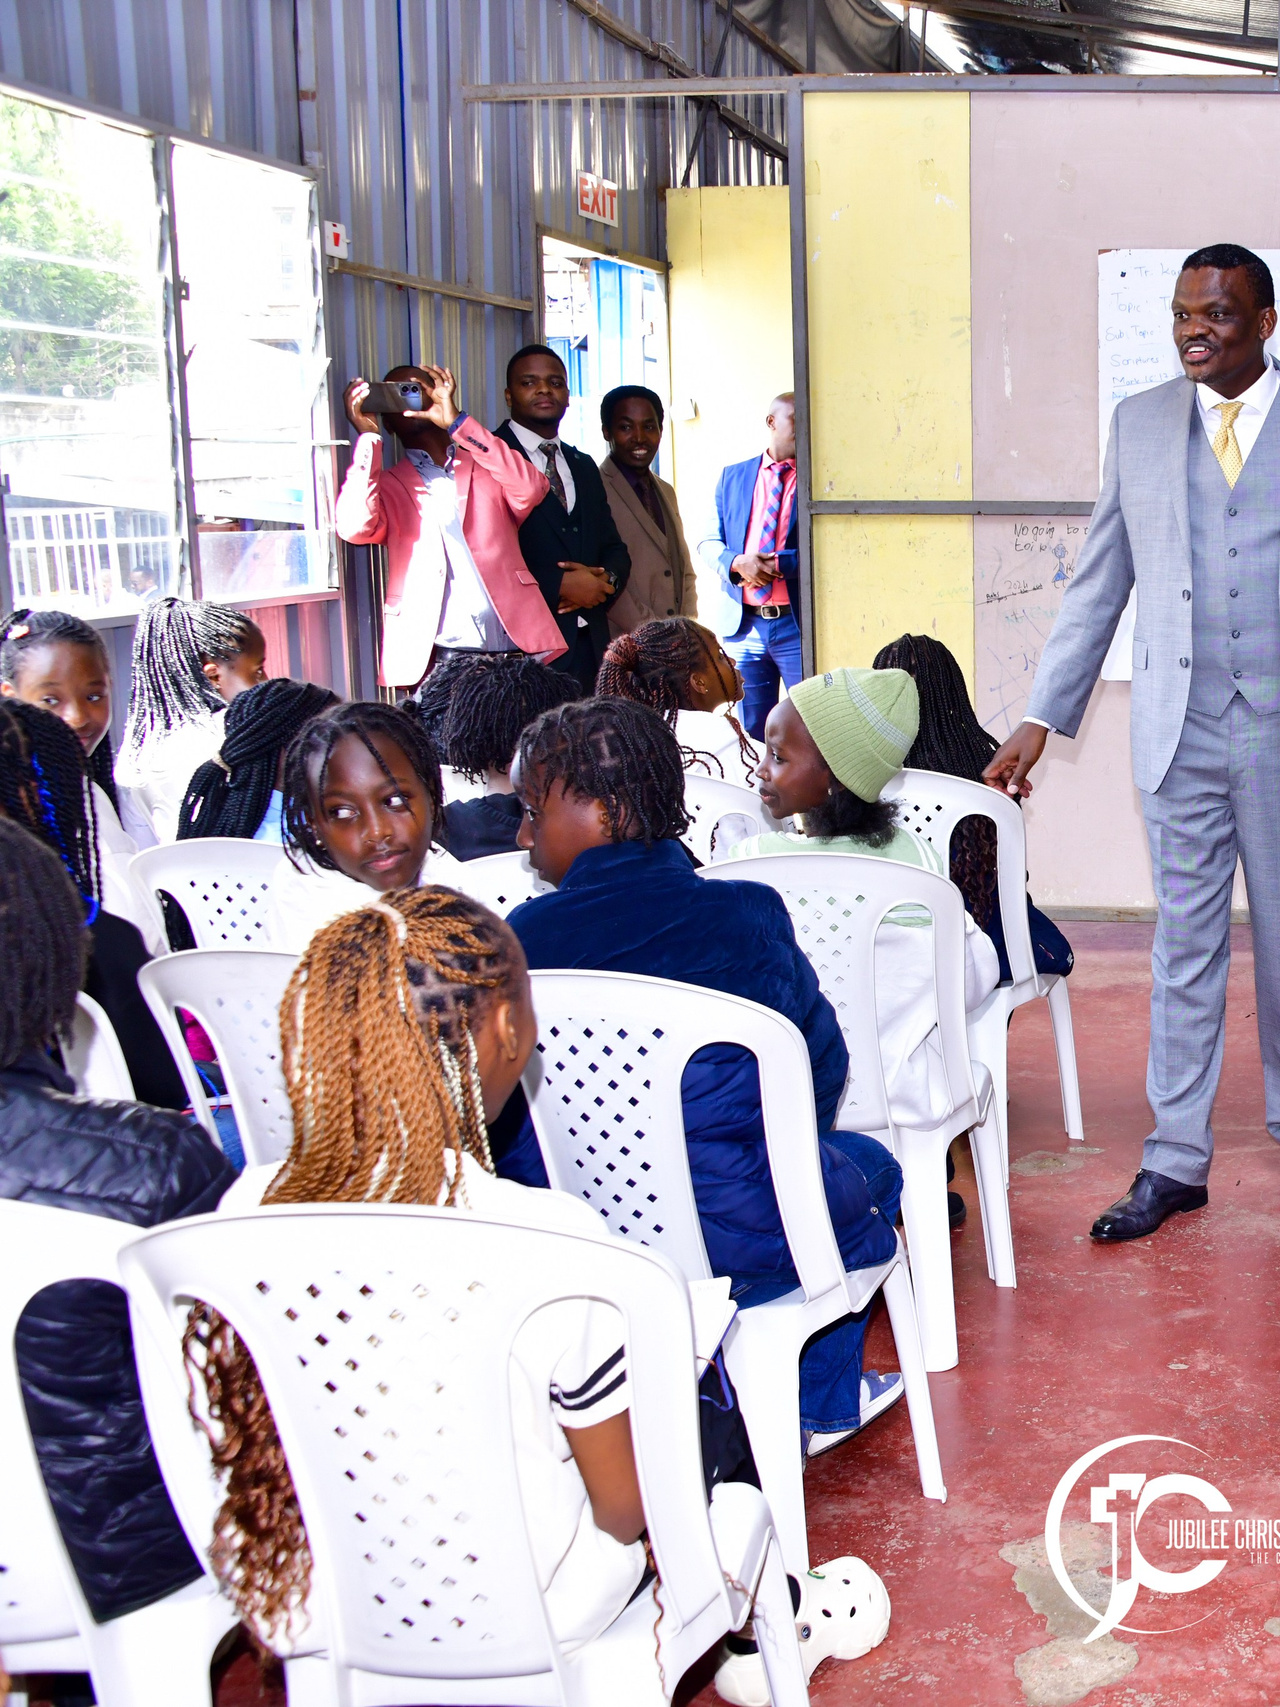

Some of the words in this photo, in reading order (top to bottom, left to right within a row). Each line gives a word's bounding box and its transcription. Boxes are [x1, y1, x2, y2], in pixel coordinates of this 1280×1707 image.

[580, 176, 617, 221] EXIT
[1014, 523, 1030, 538] No
[1066, 523, 1080, 535] to
